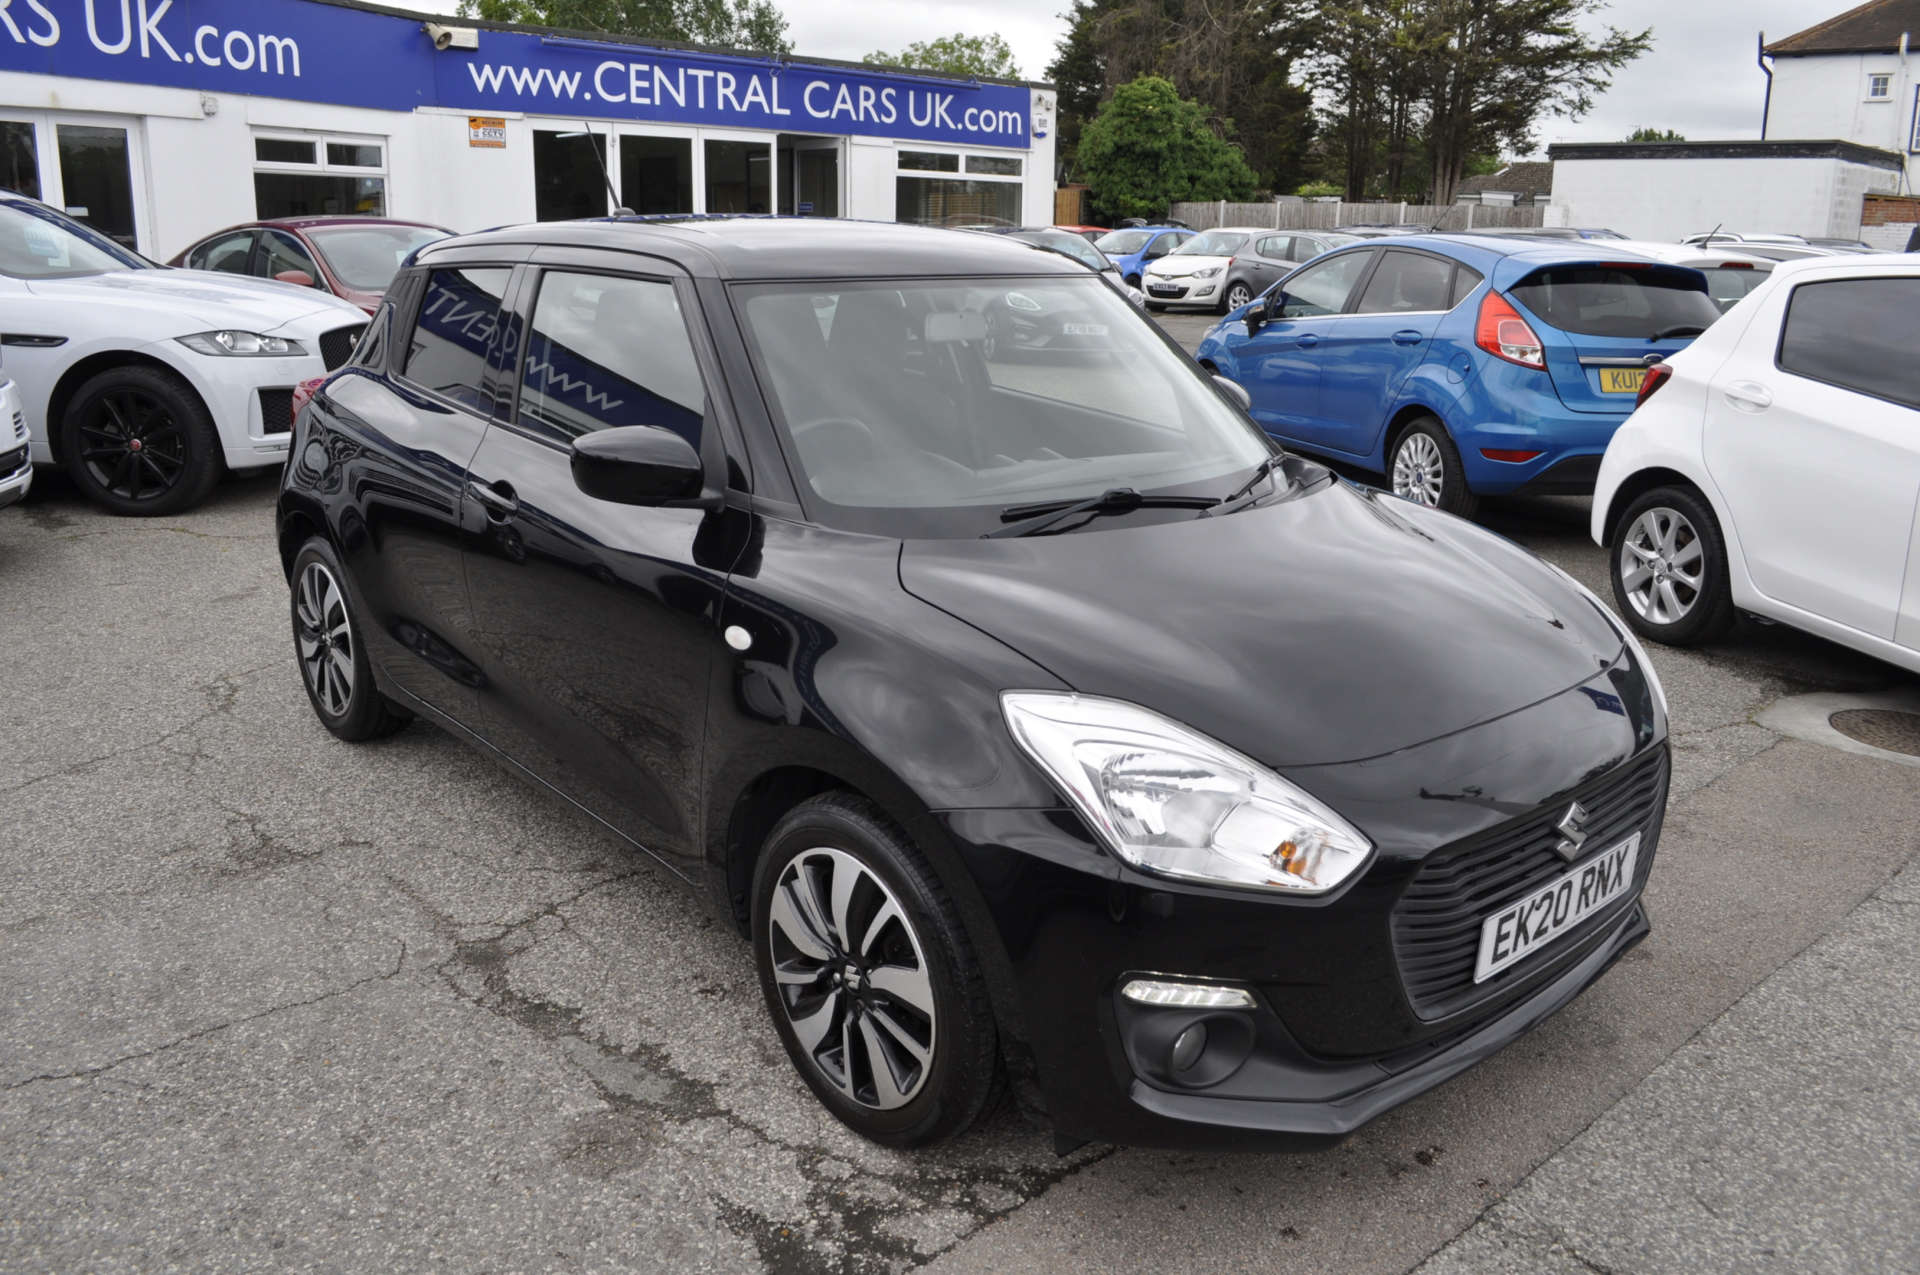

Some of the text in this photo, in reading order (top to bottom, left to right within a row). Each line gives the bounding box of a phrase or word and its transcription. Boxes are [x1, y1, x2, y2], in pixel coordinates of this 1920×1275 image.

[85, 0, 300, 77] UK.com
[467, 60, 1022, 135] www.CENTRAL CARS UK.com
[1491, 844, 1630, 965] EK20 RNX
